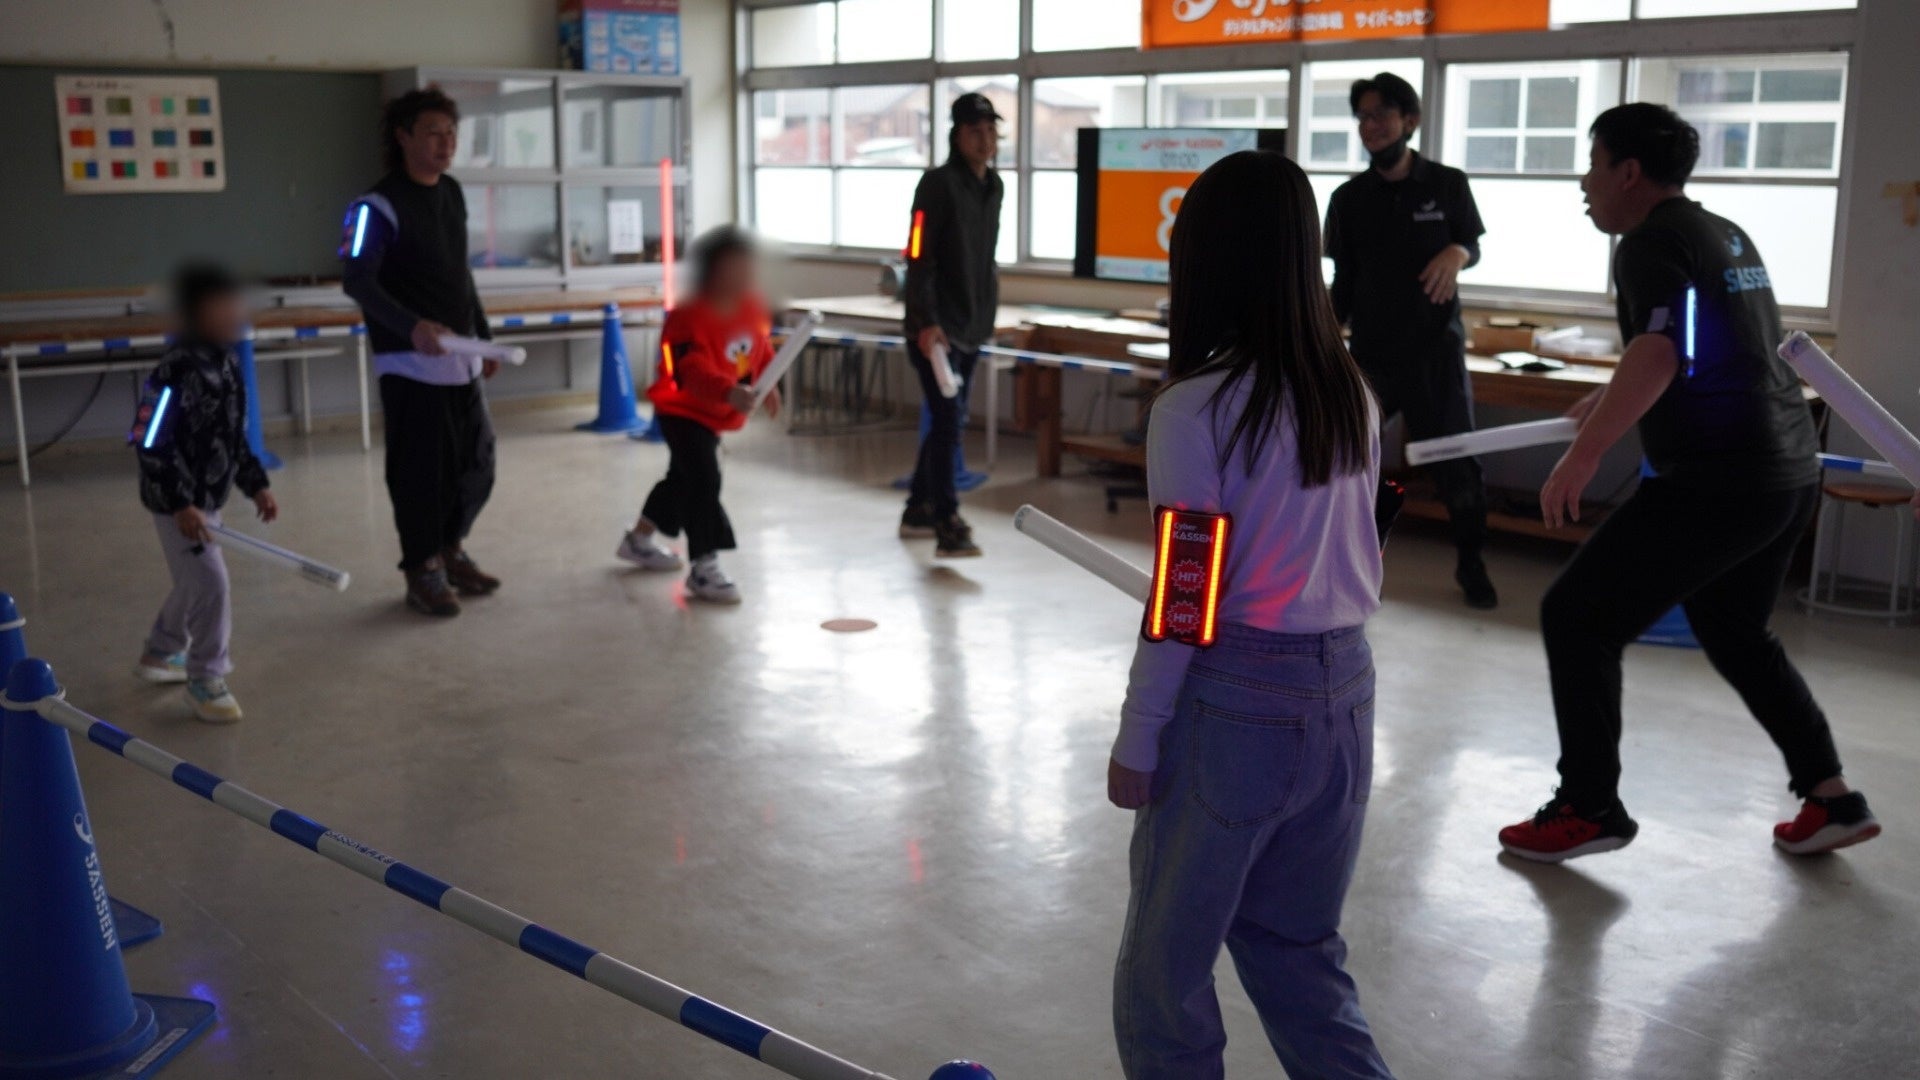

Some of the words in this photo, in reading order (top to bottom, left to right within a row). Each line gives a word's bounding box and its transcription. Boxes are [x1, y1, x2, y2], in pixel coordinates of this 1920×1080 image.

[1173, 531, 1214, 543] KASSEN
[1178, 571, 1200, 582] HIT
[1173, 613, 1195, 624] HIT
[85, 851, 116, 951] SASSEN
